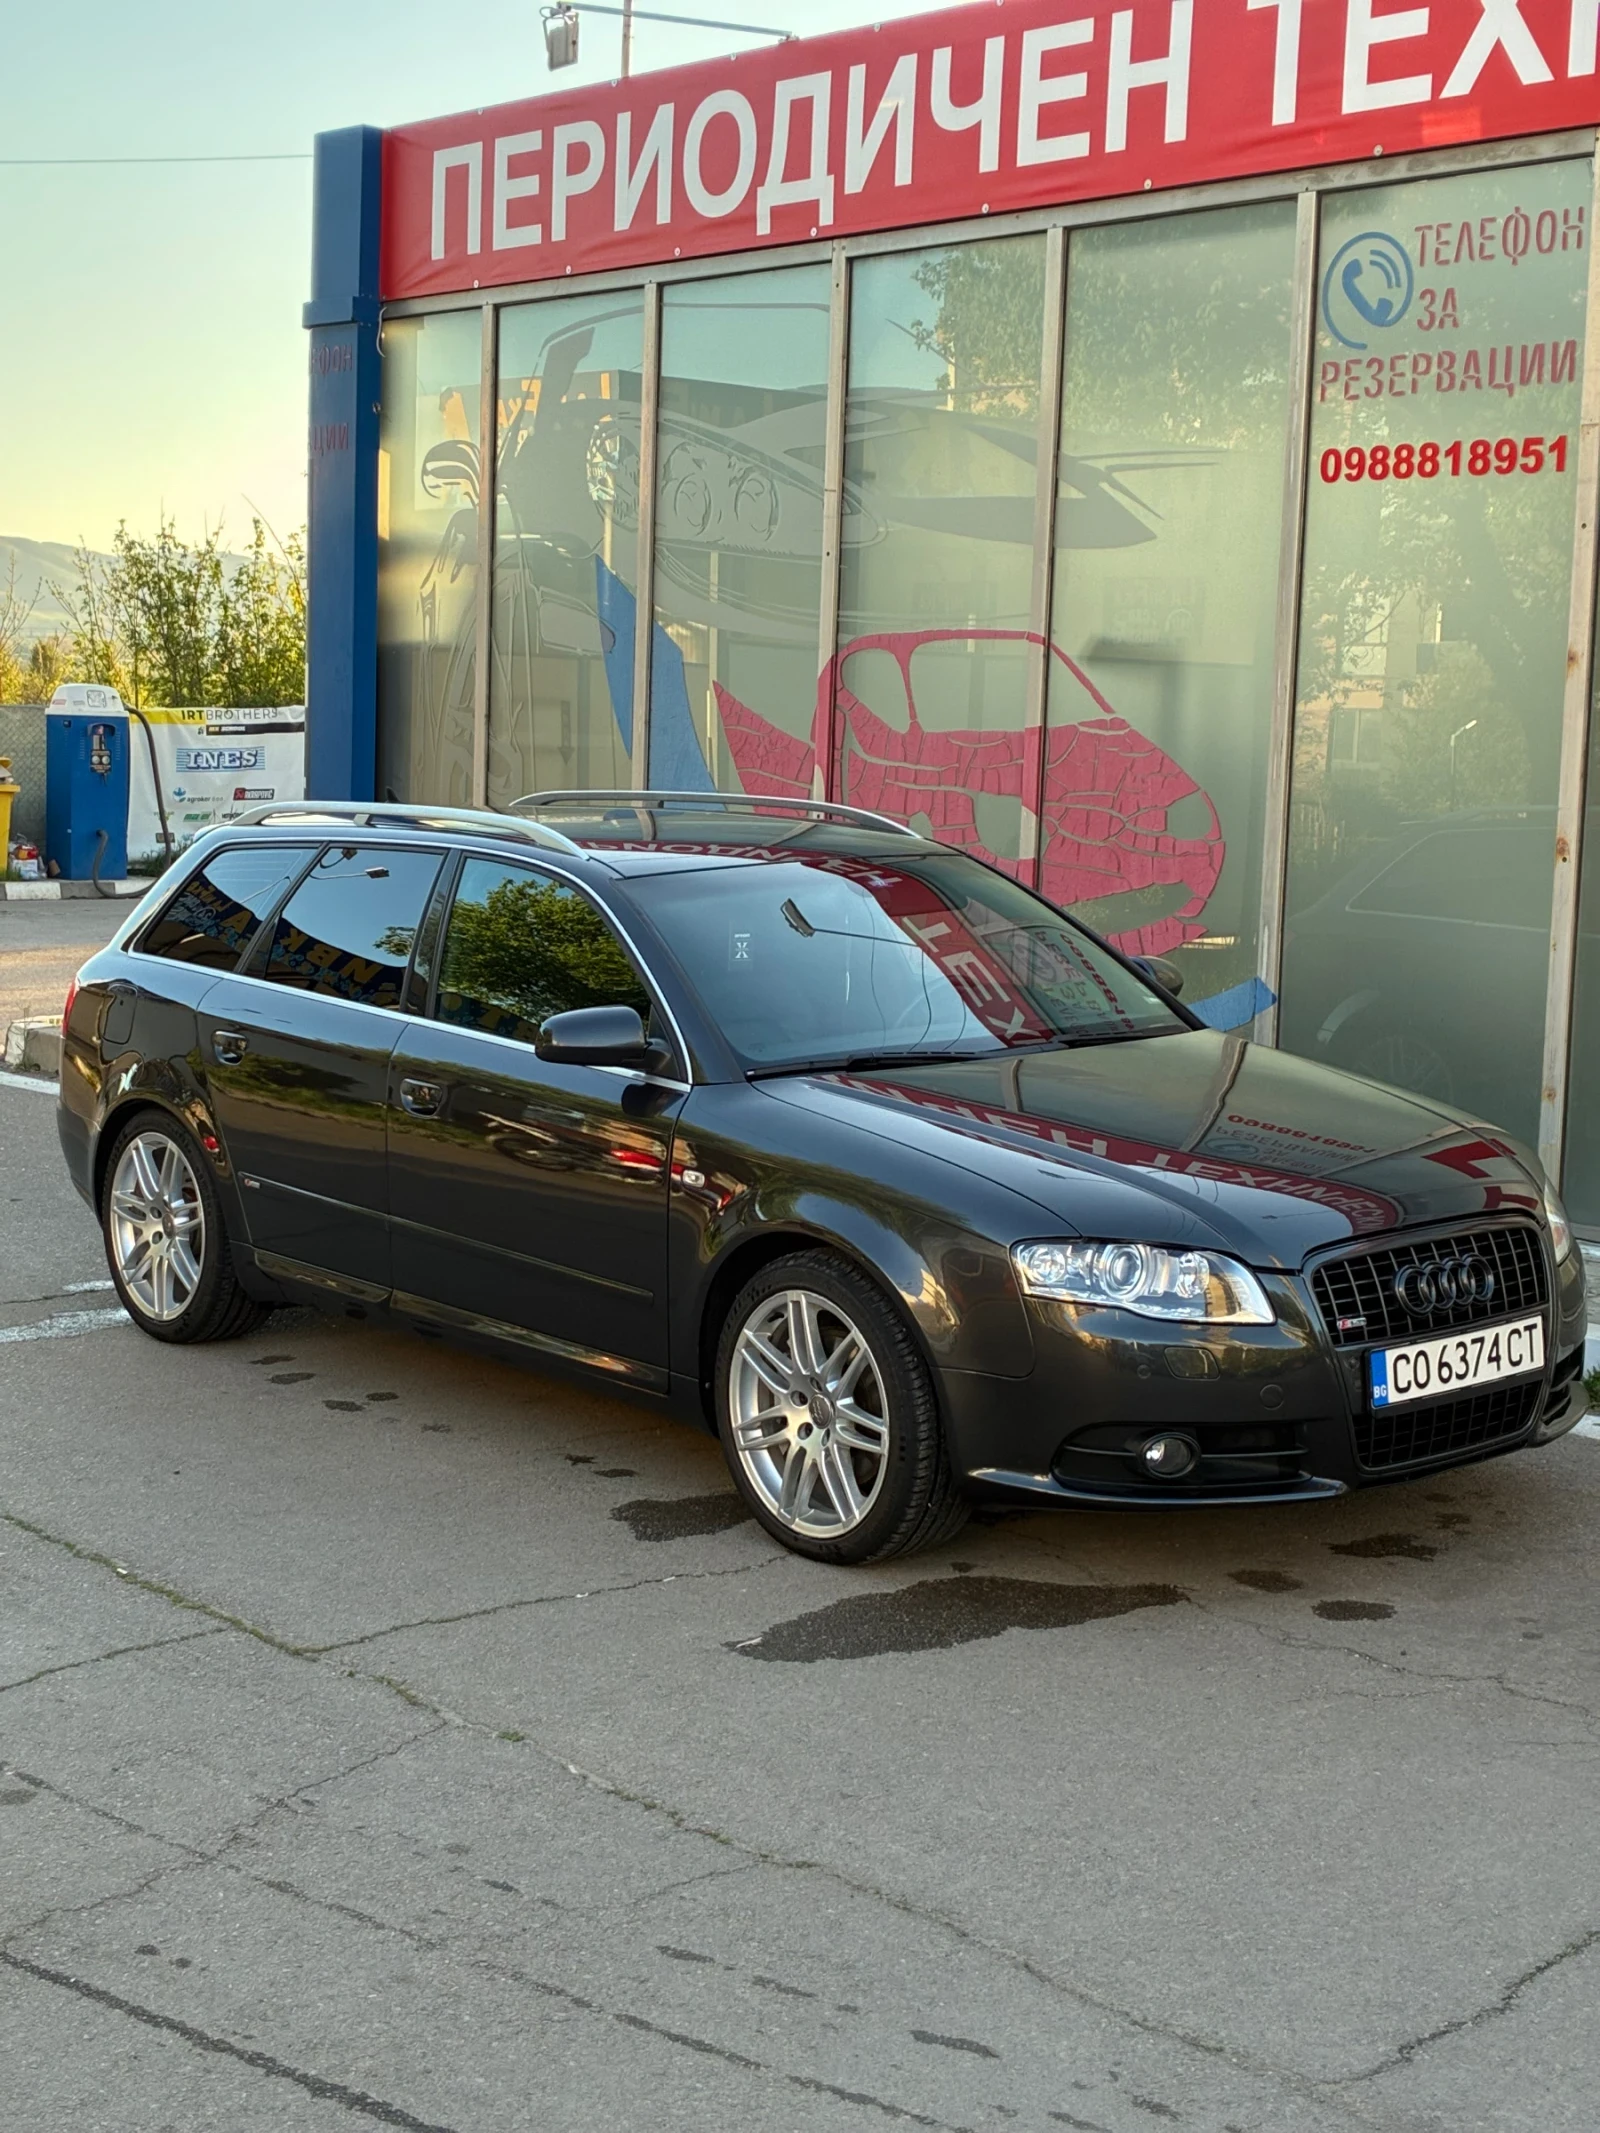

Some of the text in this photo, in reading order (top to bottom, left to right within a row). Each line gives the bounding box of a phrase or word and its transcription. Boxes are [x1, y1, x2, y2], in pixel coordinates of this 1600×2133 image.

[431, 0, 1194, 261] ПЕРИОДИЧЕН
[1414, 206, 1585, 267] ТЕЛЕФОН
[1416, 287, 1460, 331] ЗА
[1320, 339, 1578, 402] РЕЗЕРВАЦИИ
[1320, 435, 1568, 483] 0988818951
[186, 749, 258, 769] INES
[1393, 1323, 1538, 1394] CO 6374 CT
[1373, 1385, 1387, 1398] BG
